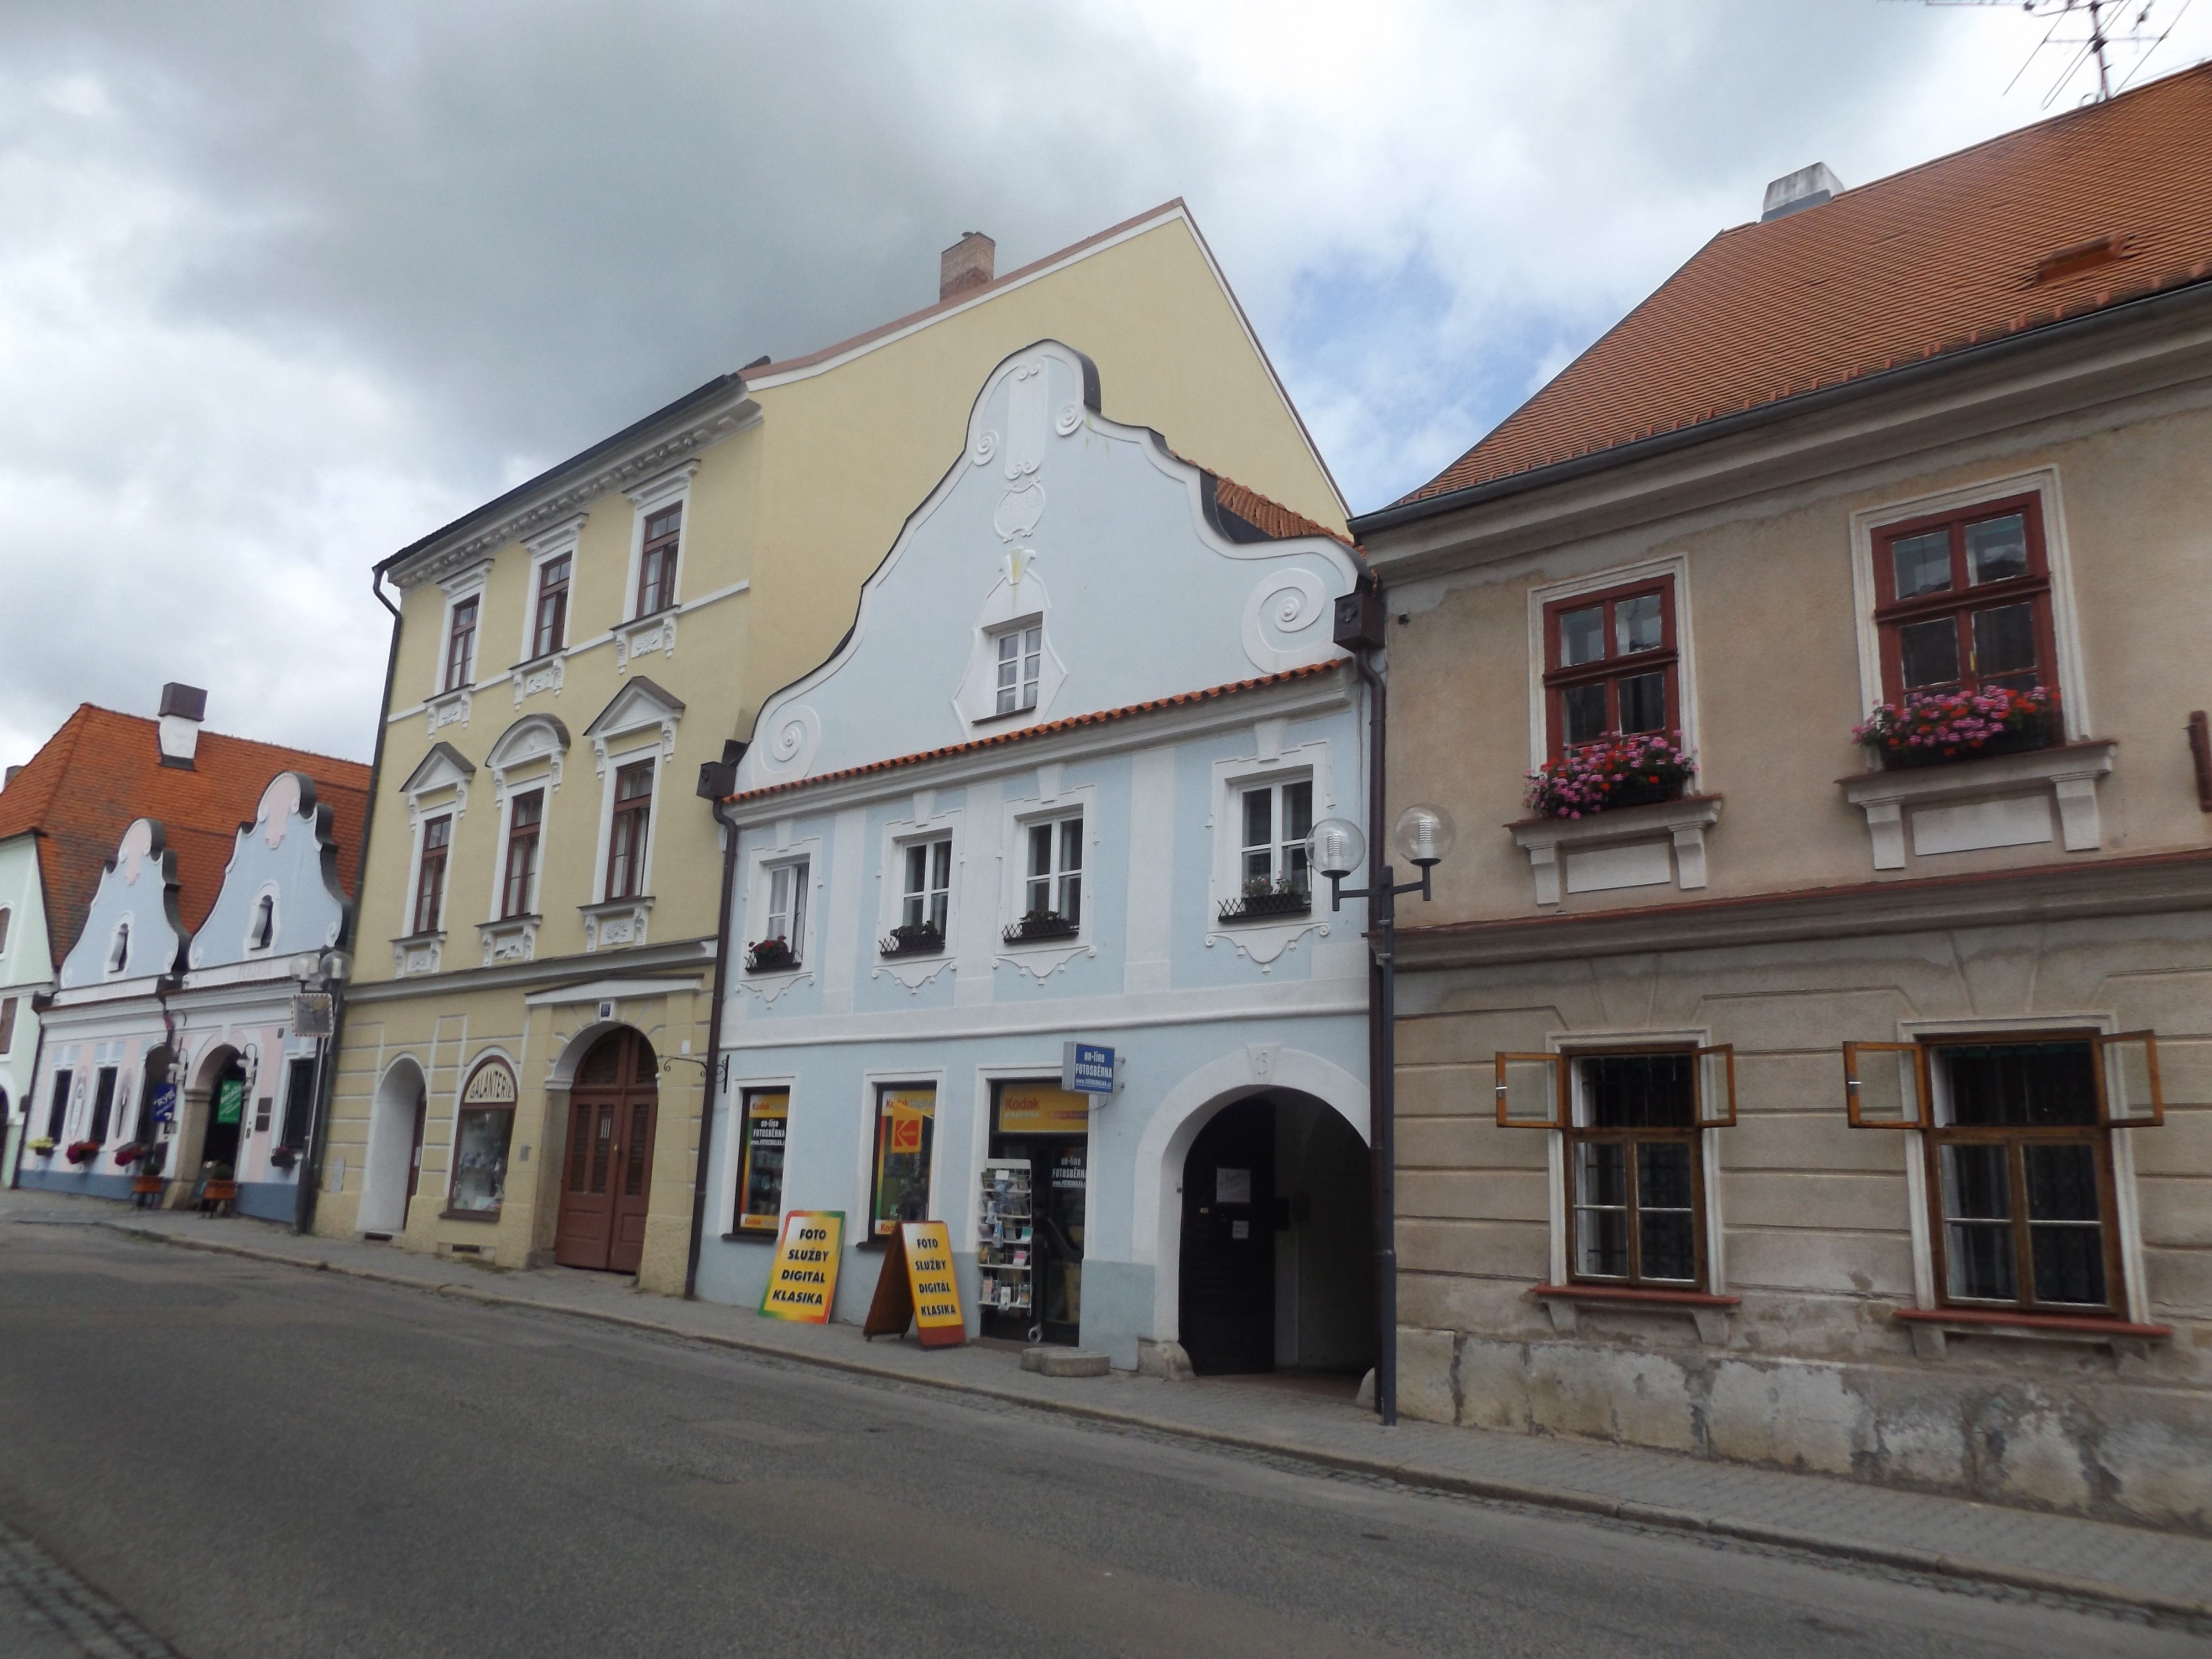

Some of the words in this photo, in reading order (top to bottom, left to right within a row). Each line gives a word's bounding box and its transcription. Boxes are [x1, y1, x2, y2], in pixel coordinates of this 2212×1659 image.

[1084, 1051, 1105, 1063] on-line
[470, 1070, 512, 1099] GALANTERIE
[752, 1102, 770, 1111] Kodak
[1005, 1098, 1040, 1110] Kodak
[761, 1119, 779, 1128] on-line
[1061, 1156, 1081, 1166] on-line
[800, 1229, 826, 1240] FOTO
[917, 1238, 938, 1248] FOTO
[787, 1248, 829, 1261] SLUŽBY
[915, 1258, 946, 1270] SLUŽBY
[781, 1269, 825, 1283] DIGITÁL
[919, 1280, 951, 1293] DIGITÁL
[772, 1289, 822, 1304] KLASIKA
[920, 1304, 956, 1316] KLASIKA
